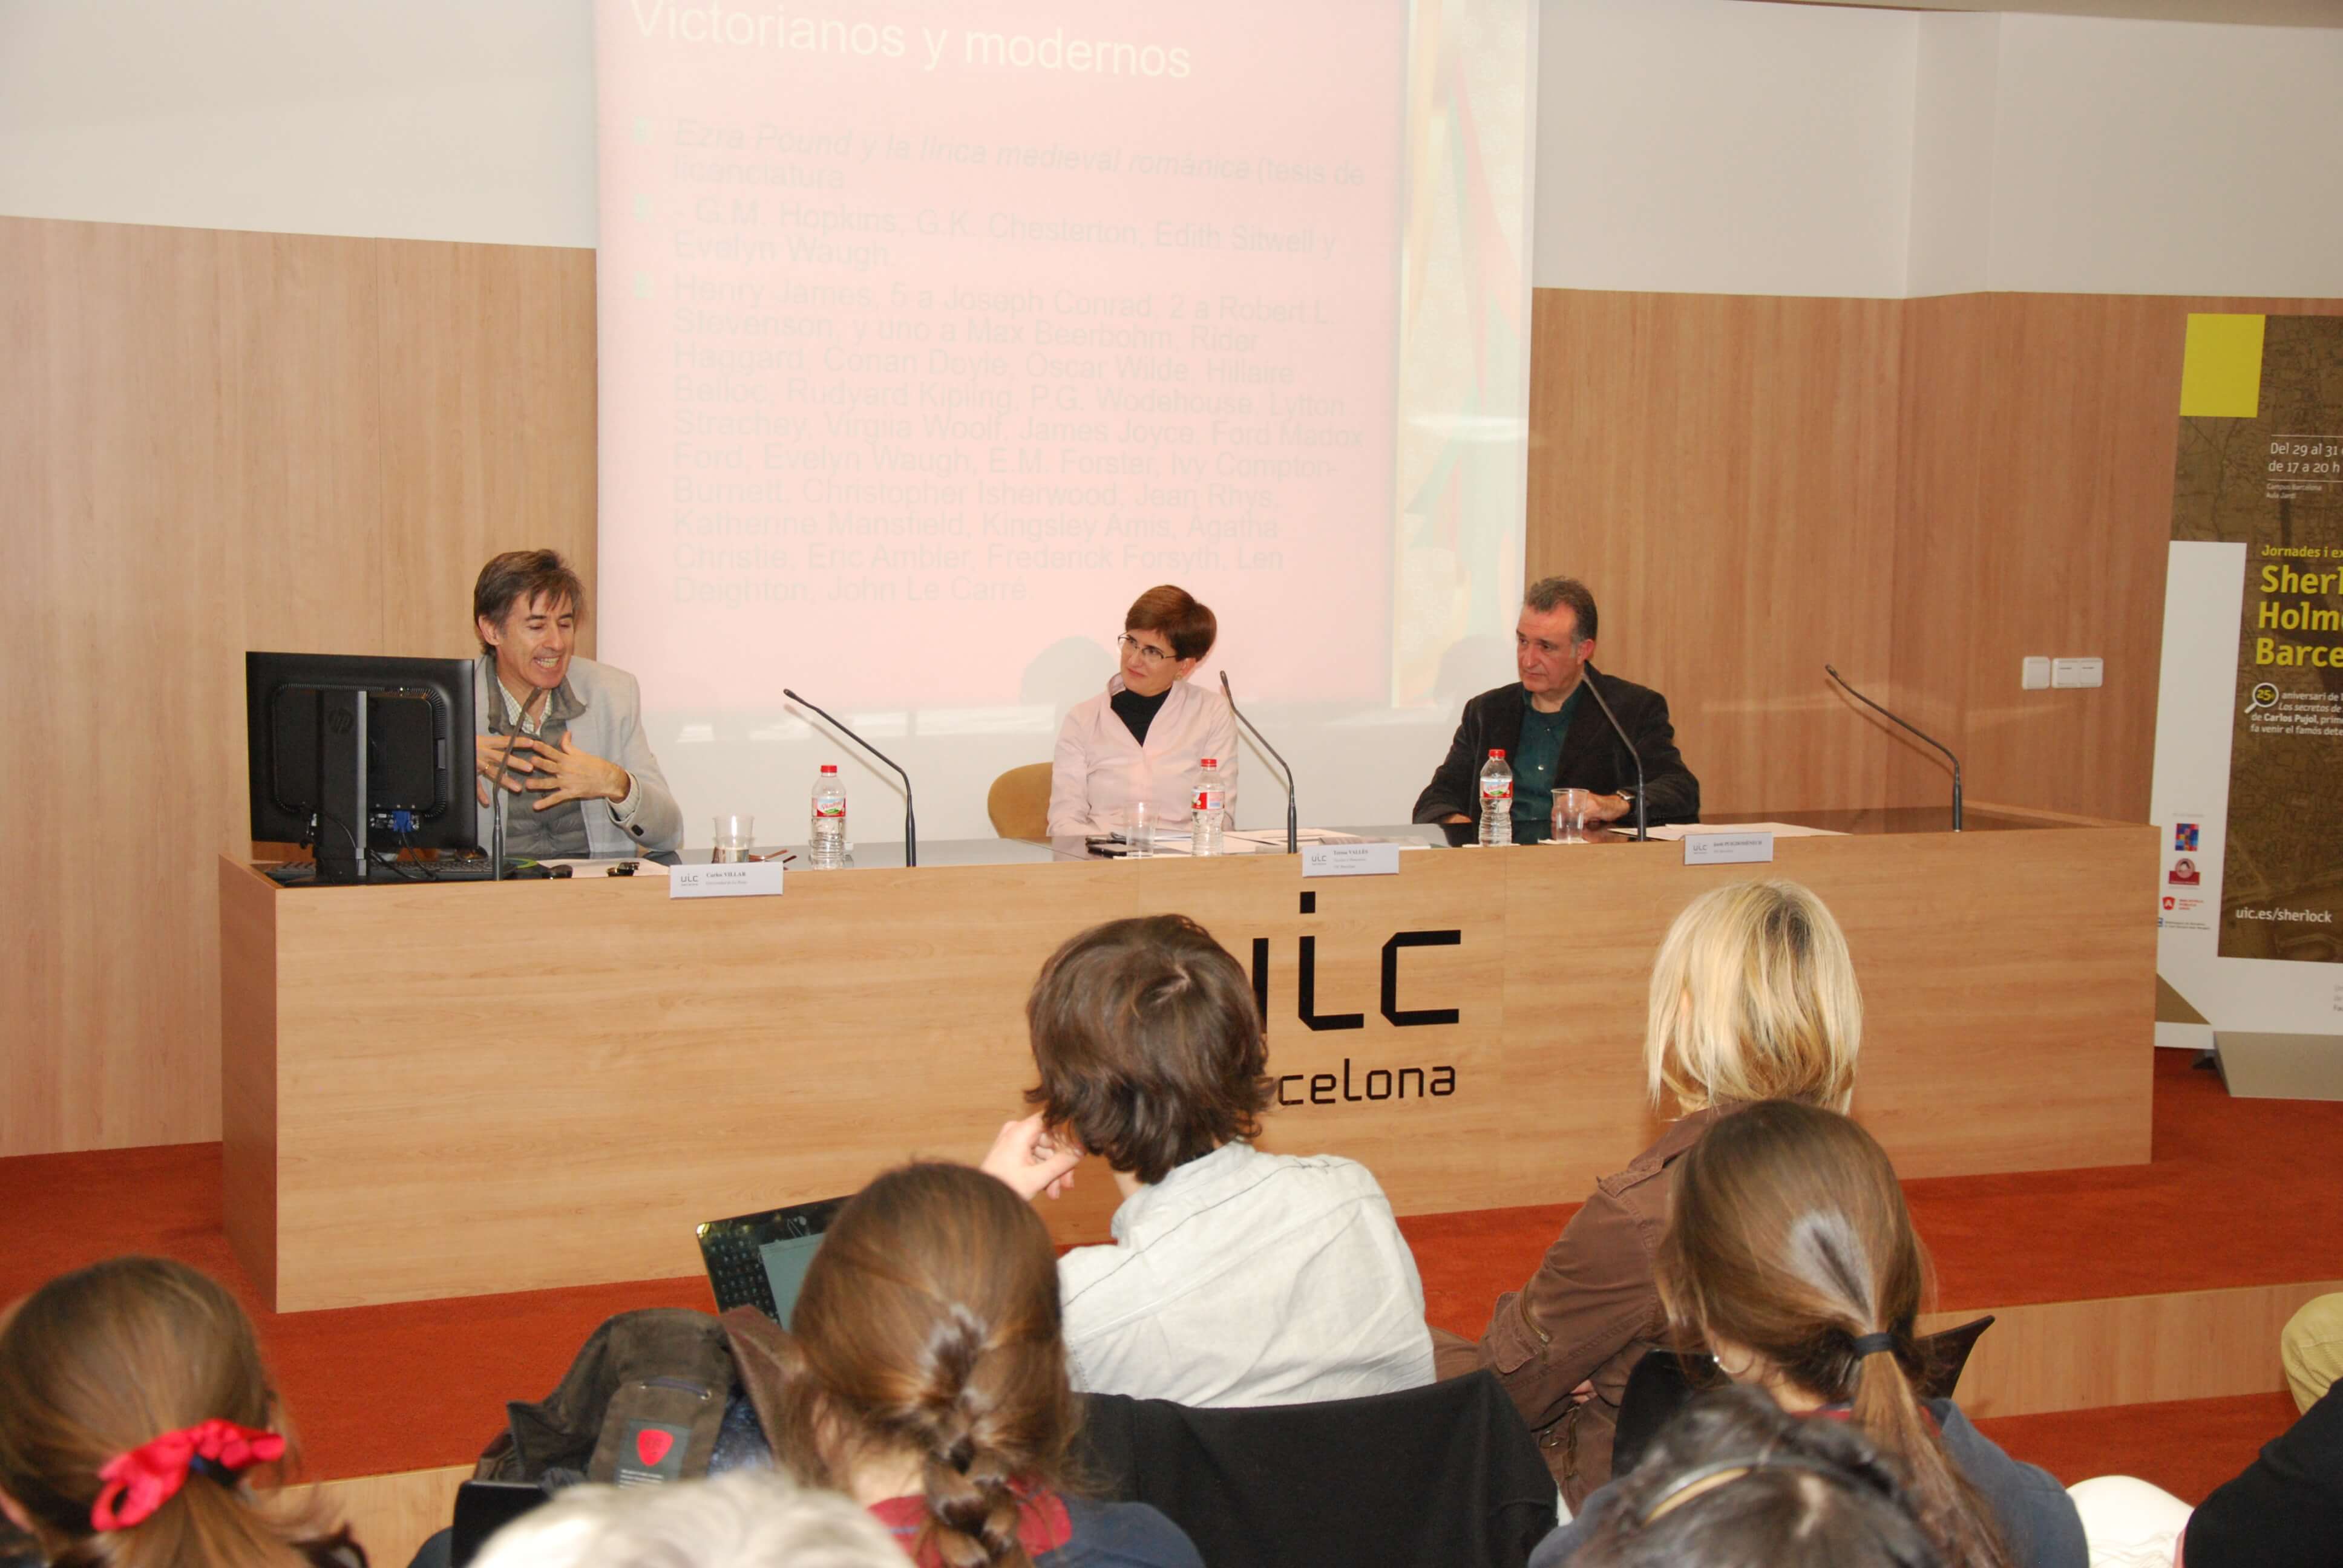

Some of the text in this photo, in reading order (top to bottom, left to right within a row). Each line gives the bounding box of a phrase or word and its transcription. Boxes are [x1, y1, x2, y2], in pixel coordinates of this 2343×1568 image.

[631, 0, 1192, 78] Victorianos y modernos
[674, 119, 745, 149] Ezra
[755, 122, 853, 155] Pound
[859, 137, 877, 165] y
[885, 134, 911, 160] la
[995, 142, 1121, 174] medieval
[1334, 155, 1365, 186] de
[672, 155, 845, 189] licenciatura
[695, 195, 766, 226] G.M.
[779, 203, 905, 237] Hopkins,
[916, 207, 976, 237] G.K.
[988, 212, 1145, 248] Chesterton,
[1155, 218, 1221, 248] Edith
[1230, 223, 1314, 252] Sitwell
[1321, 234, 1335, 260] y
[673, 229, 778, 266] Evelyn
[673, 272, 765, 309] Henry
[778, 278, 881, 310] James,
[890, 281, 906, 307] 5
[918, 289, 933, 310] a
[943, 284, 1044, 320] Joseph
[1169, 293, 1184, 320] 2
[1194, 301, 1210, 320] a
[1219, 295, 1308, 325] Robert
[852, 319, 868, 347] y
[879, 319, 931, 342] uno
[940, 322, 956, 343] a
[968, 319, 1024, 345] Max
[1191, 325, 1260, 352] Rider
[824, 345, 918, 374] Conan
[1027, 352, 1105, 379] Oscar
[787, 376, 909, 412] Rudyard
[1031, 384, 1084, 412] P.G.
[1270, 392, 1346, 422] Lytton
[1020, 416, 1109, 445] James
[1211, 420, 1270, 446] Ford
[1279, 421, 1364, 446] Madox
[764, 442, 862, 475] Evelyn
[873, 445, 978, 477] Waugh,
[989, 447, 1050, 475] E.M.
[1061, 448, 1161, 479] Forster,
[1171, 452, 1208, 482] Ivy
[2270, 442, 2289, 454] Del
[2292, 445, 2308, 457] 29
[2311, 443, 2322, 455] al
[2325, 445, 2338, 457] 31
[2268, 460, 2340, 474] de 17 a 20 h
[802, 477, 966, 509] Christopher
[978, 480, 1126, 508] Isherwood,
[1135, 484, 1198, 508] Jean
[827, 511, 971, 539] Mansfield,
[982, 512, 1098, 542] Kingsley
[1187, 514, 1279, 544] Agatha
[808, 543, 862, 570] Eric
[987, 544, 1113, 570] Frederick
[1238, 546, 1283, 570] Len
[2261, 544, 2321, 557] Jornades
[2324, 546, 2328, 557] i
[827, 576, 895, 602] John
[909, 577, 940, 602] Le
[2258, 601, 2343, 631] Holm
[2255, 638, 2343, 668] Barce
[2279, 702, 2292, 711] Los
[2331, 704, 2341, 713] de
[2281, 691, 2326, 701] aniversari
[2327, 692, 2339, 701] de
[2251, 724, 2259, 732] fa
[2295, 725, 2322, 735] famós
[2264, 713, 2292, 722] Carlos
[2294, 714, 2319, 725] Pujol,
[2235, 907, 2332, 923] uic.es/sherlock
[1278, 1058, 1456, 1106] celona
